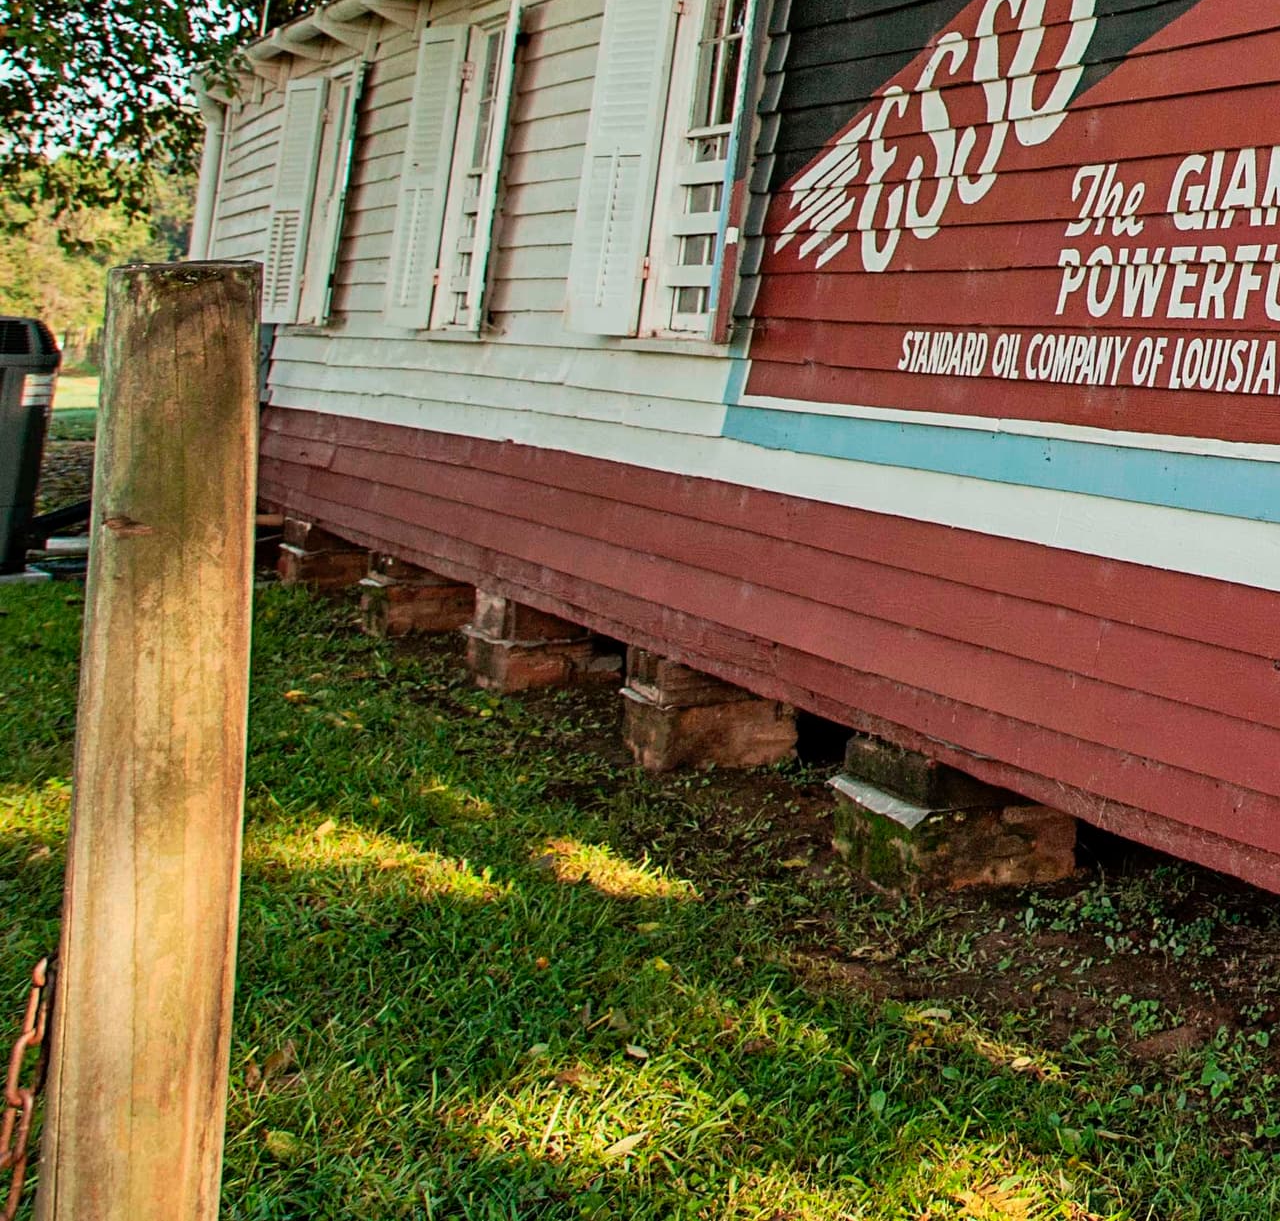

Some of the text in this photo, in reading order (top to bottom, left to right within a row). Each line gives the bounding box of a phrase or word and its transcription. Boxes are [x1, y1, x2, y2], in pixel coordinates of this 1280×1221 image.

[1064, 164, 1144, 237] The
[898, 330, 989, 377] STANDARD
[992, 334, 1023, 379] OIL
[1025, 335, 1131, 385] COMPANY
[1133, 336, 1167, 387] OF
